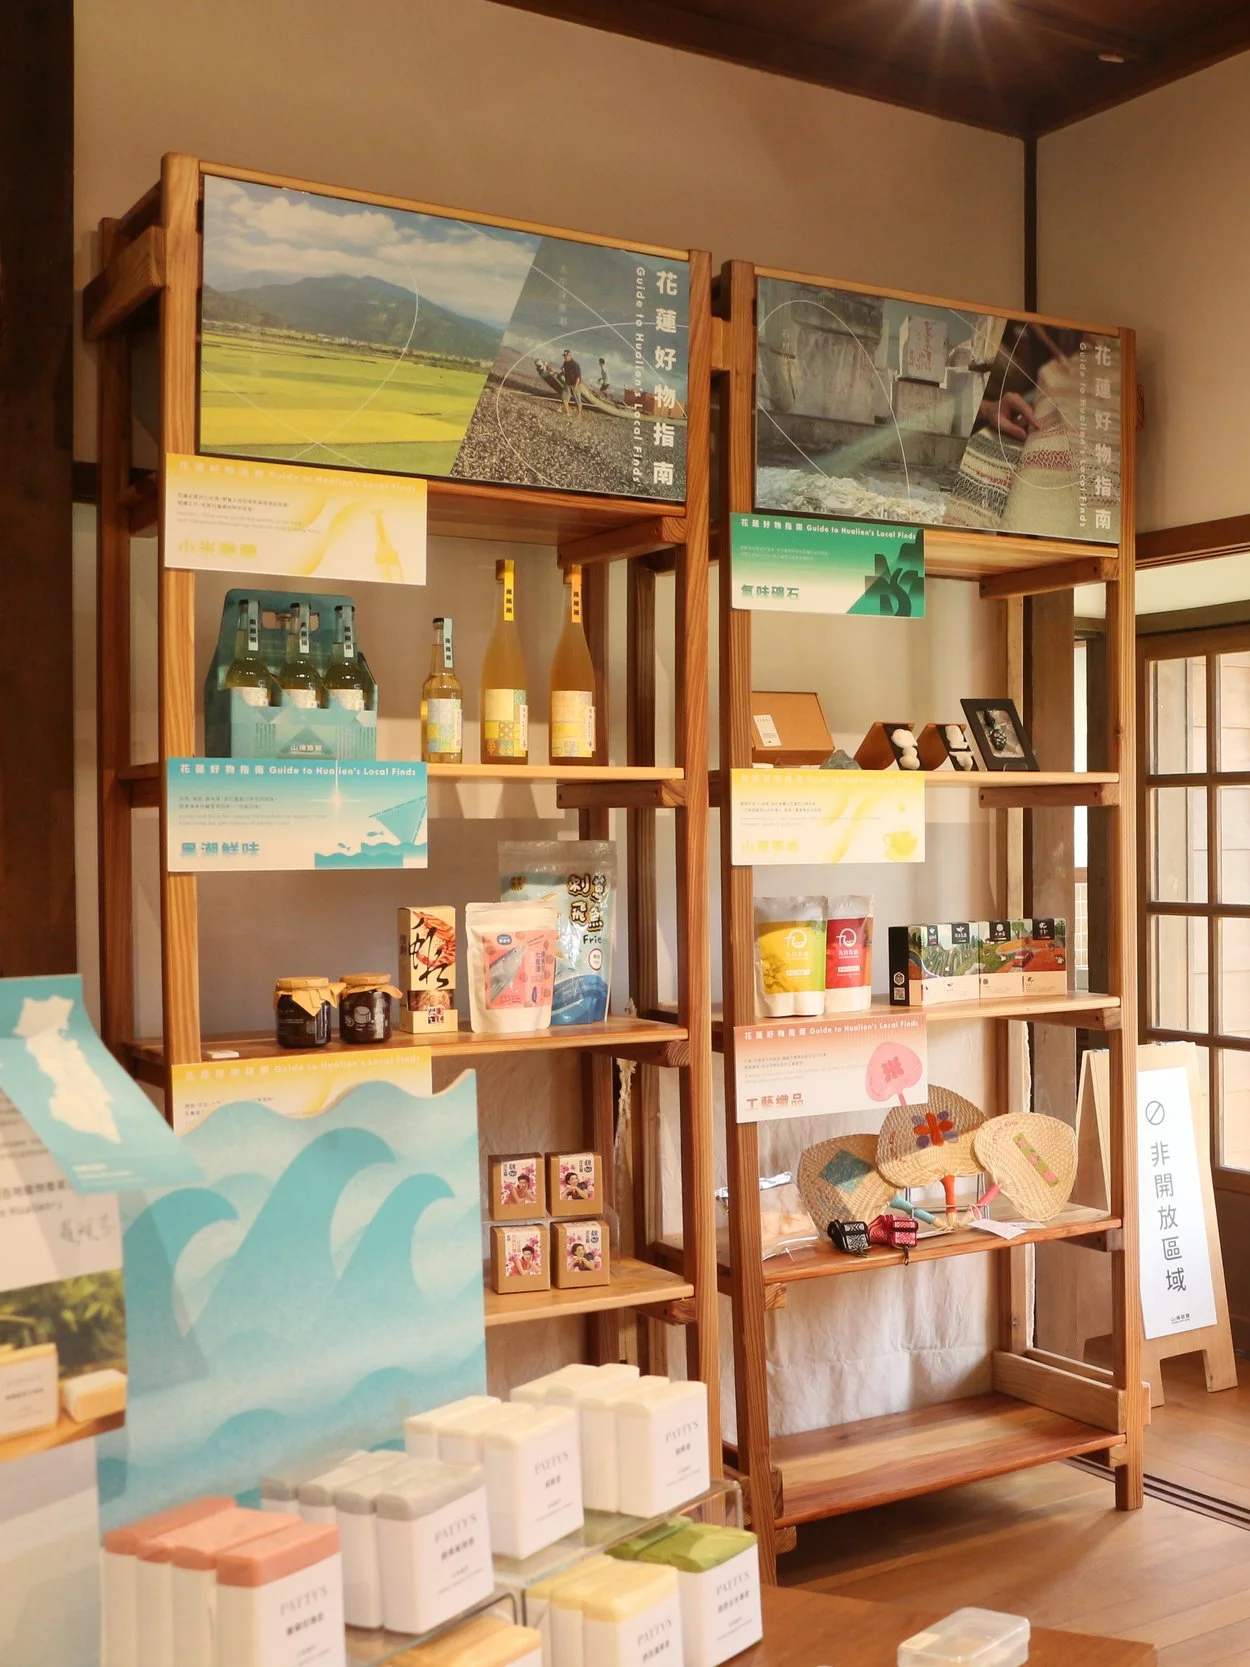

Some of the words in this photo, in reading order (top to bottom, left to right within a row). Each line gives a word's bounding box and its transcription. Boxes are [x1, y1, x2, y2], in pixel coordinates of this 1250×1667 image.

[636, 266, 645, 308] Guide
[635, 312, 644, 327] to
[633, 333, 645, 398] Hualien's
[1079, 342, 1087, 377] Guide
[653, 270, 678, 486] 花蓮好物指南
[1079, 380, 1087, 393] to
[633, 403, 643, 441] Local
[1094, 344, 1112, 530] 花蓮好物指南
[632, 445, 643, 484] Finds
[1079, 459, 1088, 492] Local
[1079, 495, 1088, 528] Finds
[741, 518, 803, 532] 花蓮好物指南
[806, 524, 829, 533] Guide
[831, 526, 839, 534] to
[841, 527, 875, 537] Hualien's
[876, 530, 896, 538] Local
[897, 531, 917, 540] Finds
[180, 763, 265, 776] 花蓮好物指南
[269, 765, 299, 775] Guide
[303, 766, 312, 775] to
[316, 766, 361, 776] Hualien's
[364, 766, 389, 776] Local
[392, 767, 417, 777] Finds
[582, 935, 604, 945] Frie
[810, 1025, 832, 1035] Guide
[834, 1025, 842, 1033] to
[844, 1022, 878, 1033] Hualien's
[879, 1021, 899, 1030] Local
[900, 1020, 919, 1028] Finds
[1150, 1140, 1187, 1292] 非開放區域
